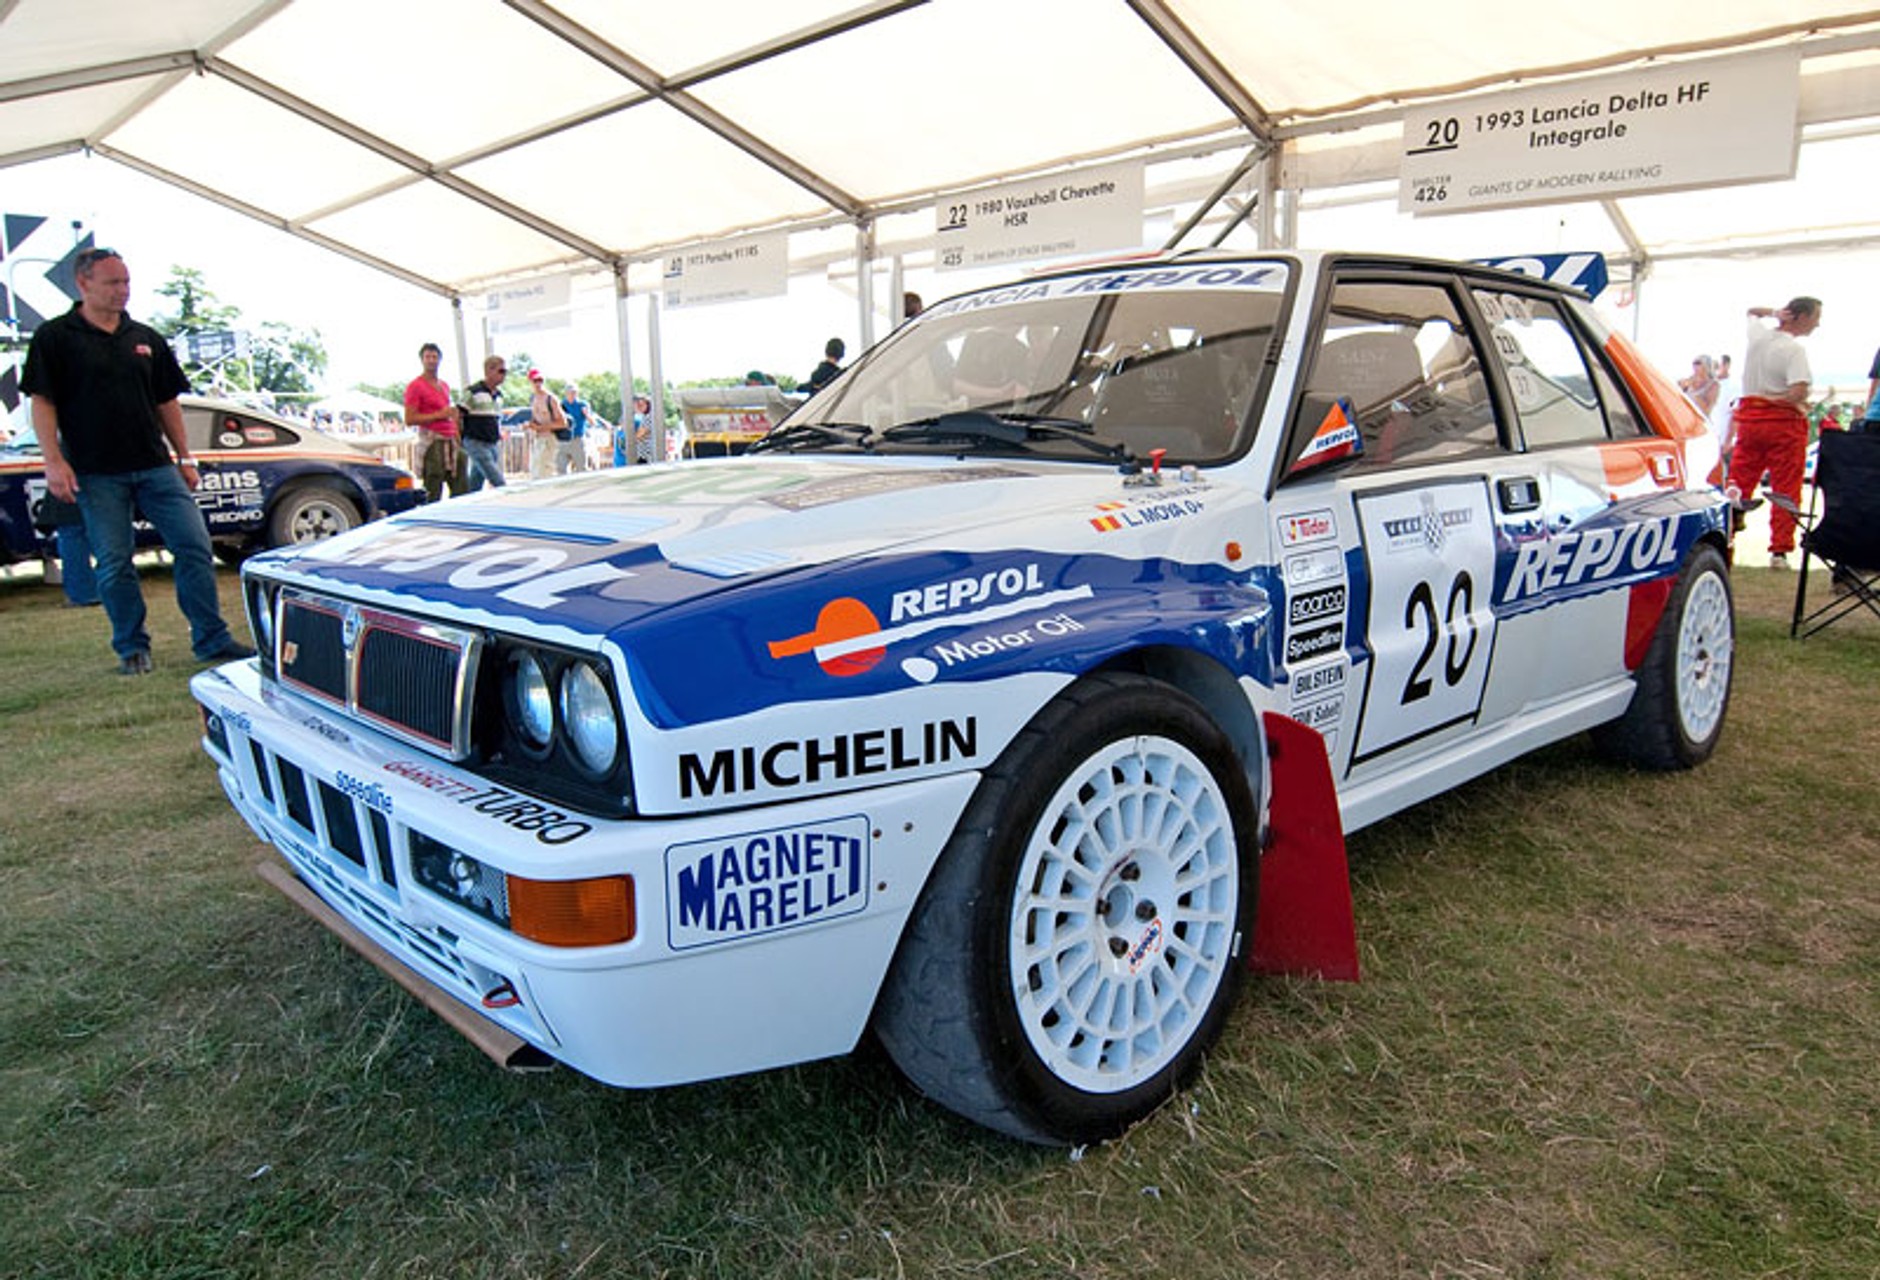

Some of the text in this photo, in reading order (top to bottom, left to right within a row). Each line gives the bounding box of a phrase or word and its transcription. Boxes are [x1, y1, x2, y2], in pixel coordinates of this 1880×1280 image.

[1474, 82, 1712, 133] 1993 Lancia Delta HF
[1426, 117, 1460, 147] 20
[1529, 119, 1628, 149] Integrale
[1412, 174, 1452, 187] SHELTER
[1414, 184, 1448, 203] 426
[1469, 164, 1662, 198] GIANTS OF MODERN RALLYING
[949, 203, 967, 225] 22
[974, 181, 1116, 216] 1980 Vauxhall Chevette
[1004, 212, 1029, 227] HSR
[1063, 266, 1275, 295] REPSOL
[209, 510, 264, 525] RECARO
[1502, 514, 1682, 602] REPSOL
[890, 564, 1044, 622] REPSOL
[934, 612, 1086, 668] Motor Oil
[1401, 570, 1477, 706] 20
[1296, 665, 1343, 694] BILSTEIN
[678, 716, 977, 800] MICHELIN
[335, 770, 395, 815] speedline
[458, 786, 593, 845] TURBO
[678, 833, 861, 893] MAGNETI
[678, 866, 861, 931] MARELLI
